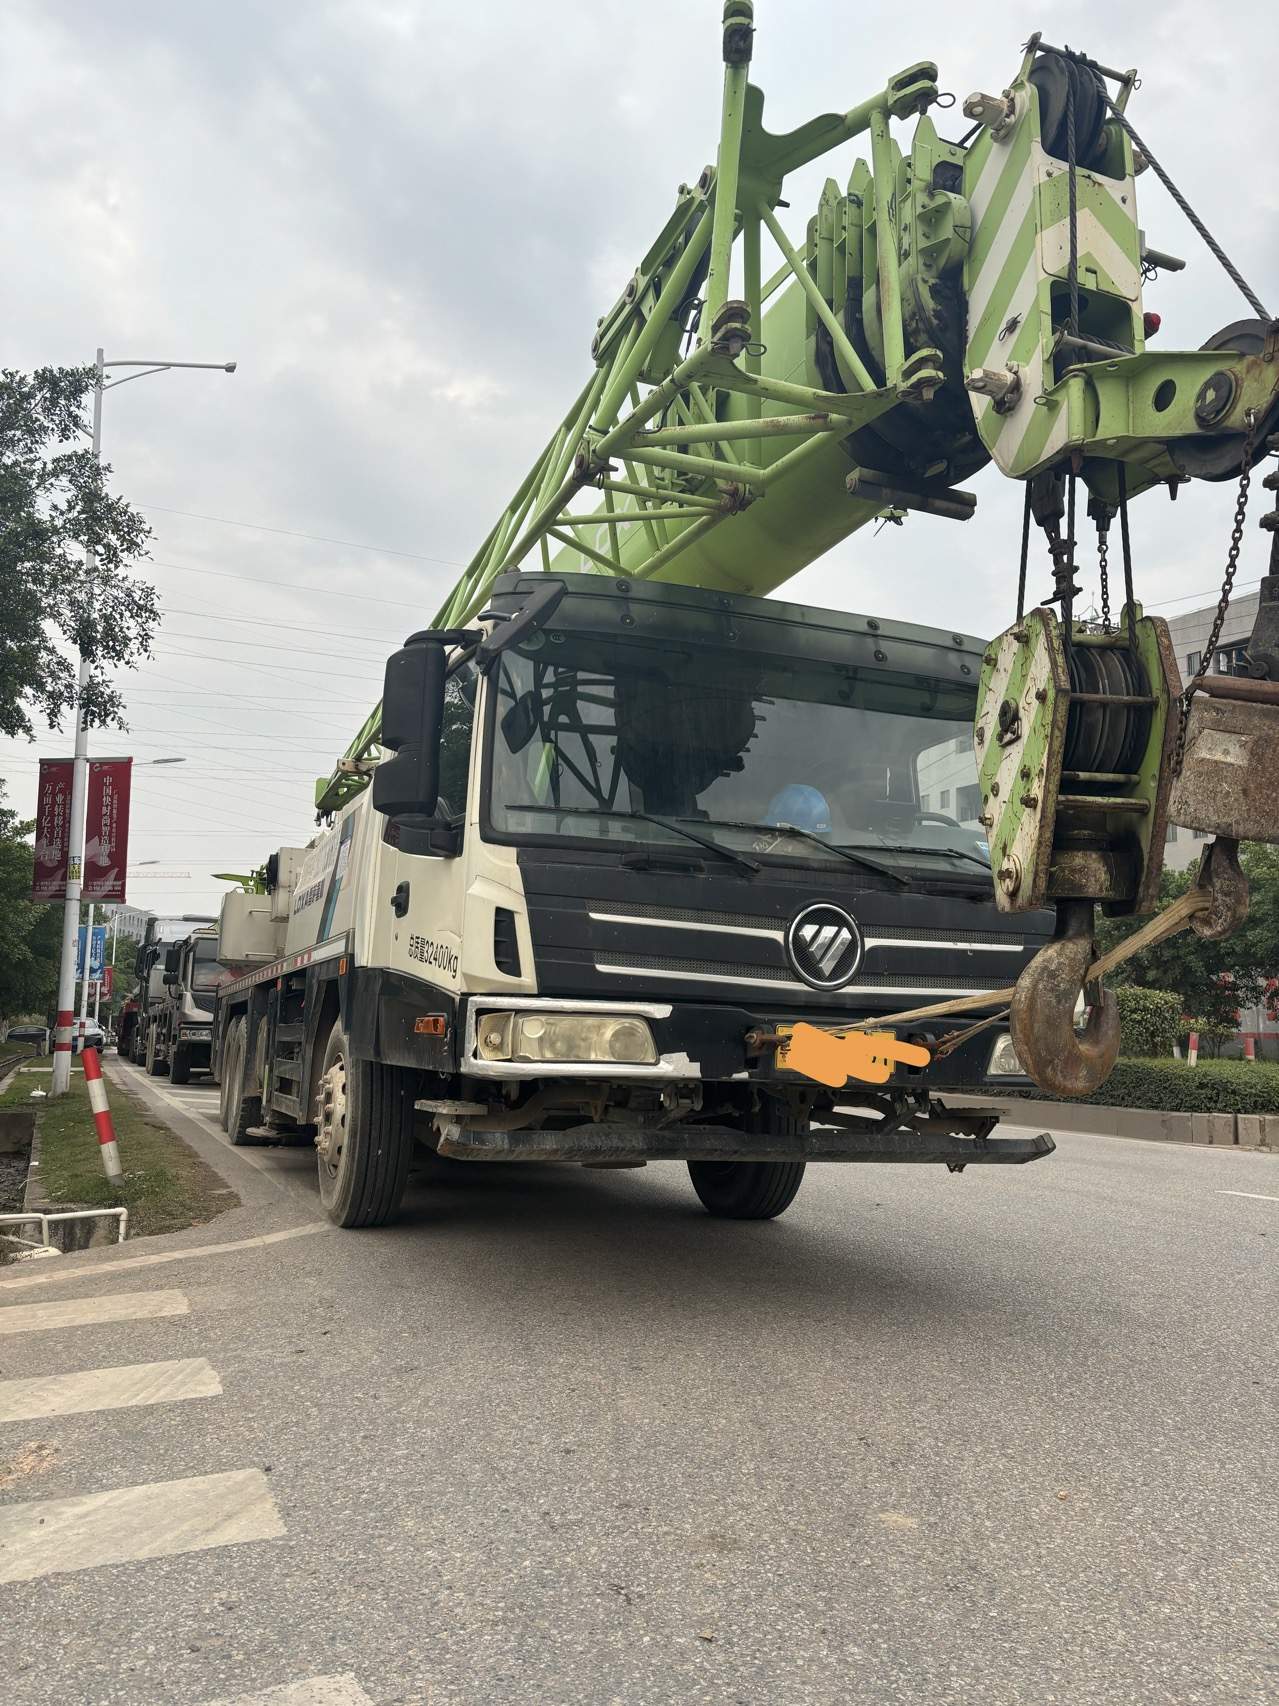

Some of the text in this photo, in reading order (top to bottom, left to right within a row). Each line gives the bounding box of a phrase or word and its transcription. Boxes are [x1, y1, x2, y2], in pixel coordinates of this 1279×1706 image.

[41, 783, 53, 861] 万亩千亿大平台
[52, 782, 65, 860] 产业转移首选地
[408, 933, 459, 979] 总质量32400kg
